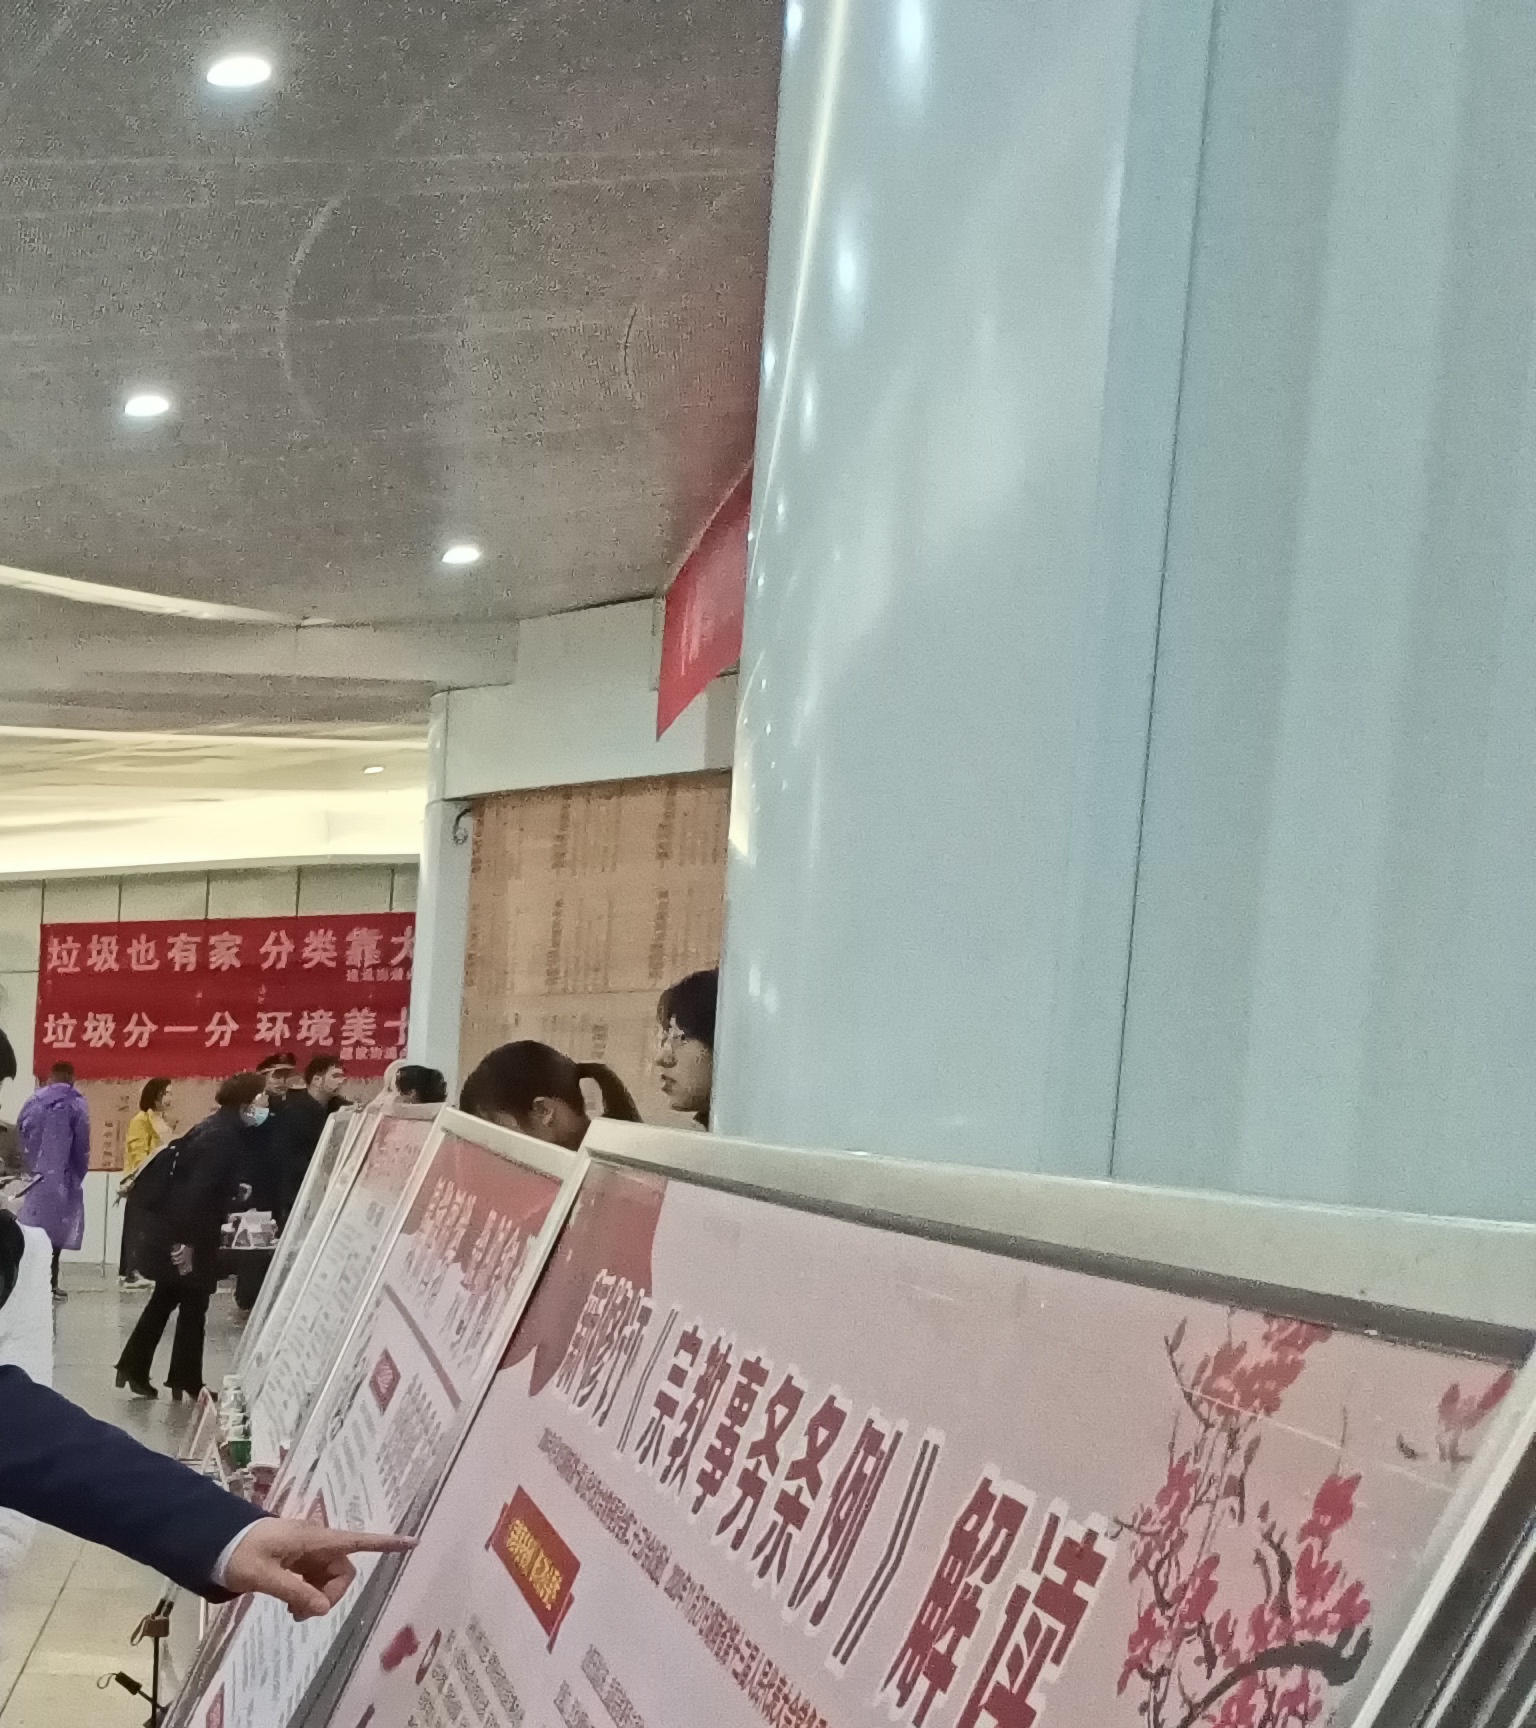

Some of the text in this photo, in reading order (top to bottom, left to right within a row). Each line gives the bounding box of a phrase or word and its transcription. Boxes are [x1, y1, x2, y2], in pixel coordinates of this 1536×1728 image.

[47, 930, 244, 974] 垃圾也有家
[43, 1010, 240, 1049] 垃圾分一分
